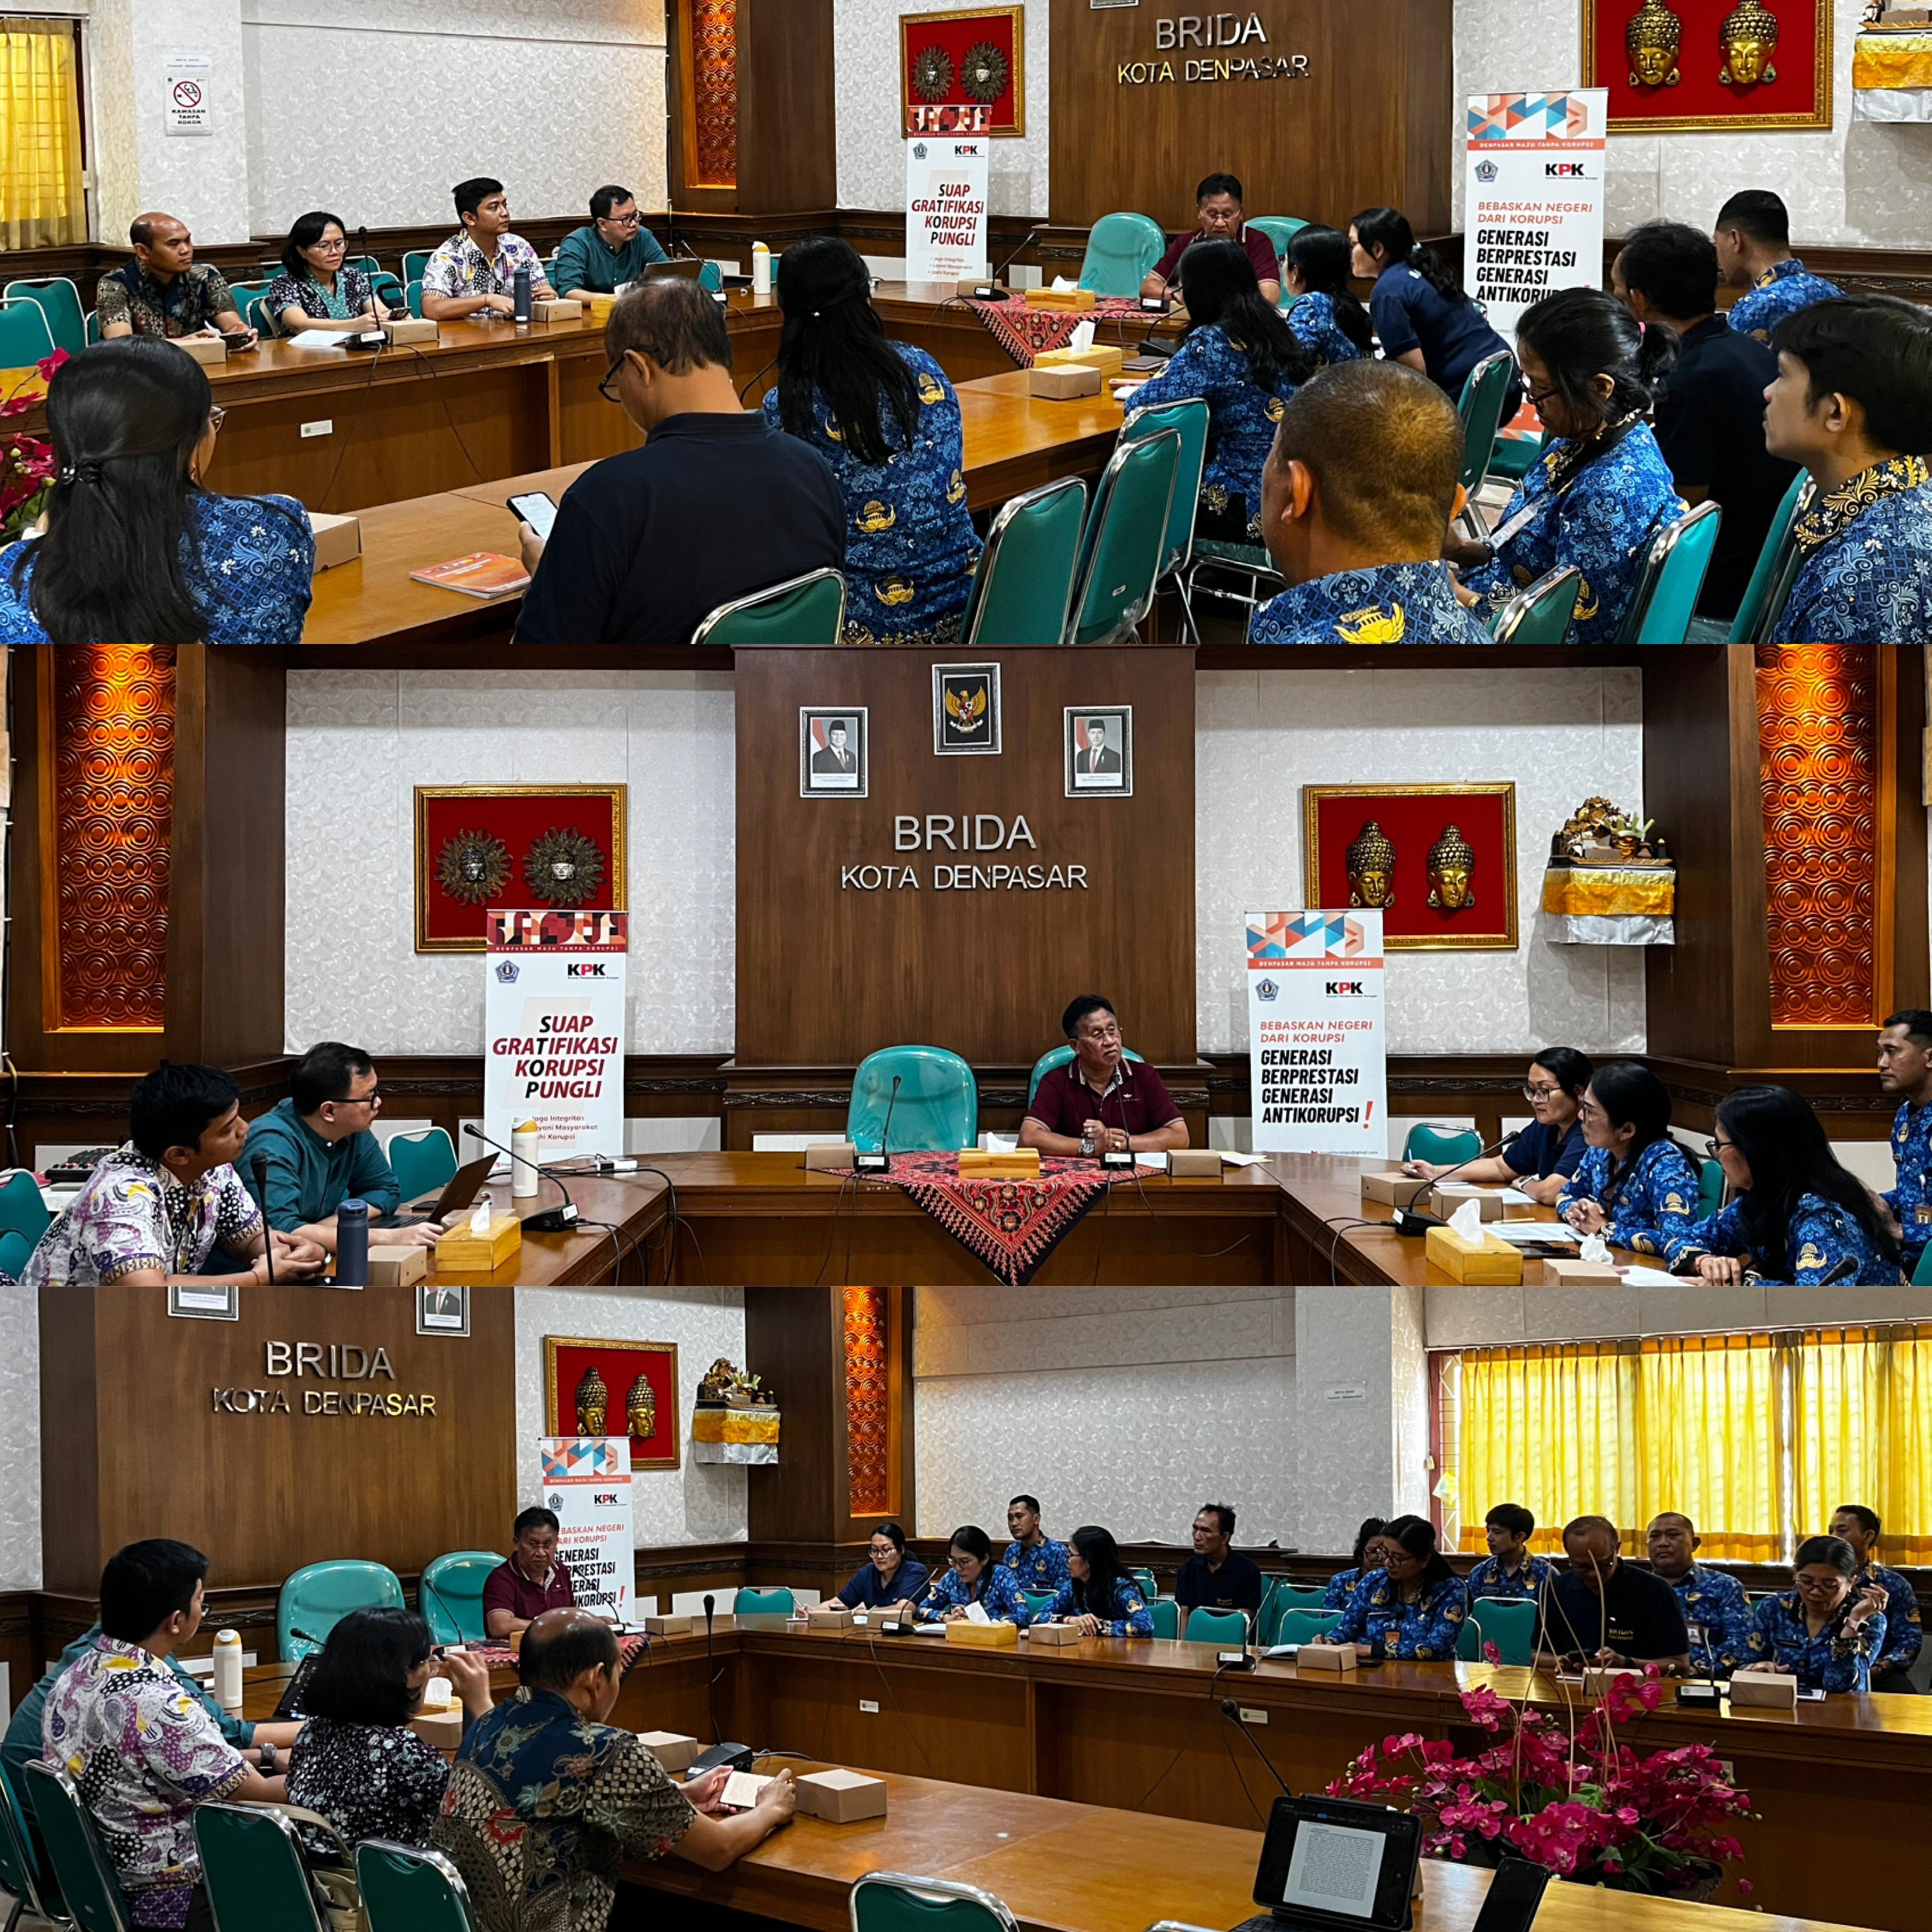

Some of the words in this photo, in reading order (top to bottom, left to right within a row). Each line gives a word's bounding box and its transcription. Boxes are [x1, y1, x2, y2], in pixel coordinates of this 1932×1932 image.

[1156, 12, 1267, 50] BRIDA
[1118, 61, 1175, 84] KOTA
[1185, 55, 1309, 81] DENPASAR
[955, 145, 977, 155] KPK
[1545, 164, 1584, 175] KPK
[938, 184, 970, 197] SUAP
[912, 199, 984, 214] GRATIFIKASI
[1479, 202, 1541, 212] BEBASKAN
[1546, 203, 1592, 213] NEGERI
[924, 216, 977, 230] KORUPSI
[1478, 214, 1505, 223] DARI
[1509, 214, 1563, 224] KORUPSI
[930, 232, 975, 246] PUNGLI
[1477, 230, 1549, 247] GENERASI
[1477, 248, 1576, 267] BERPRESTASI
[1477, 267, 1548, 284] GENERASI
[895, 814, 1037, 851] BRIDA
[841, 865, 919, 889] KOTA
[935, 865, 1087, 889] DENPASAR
[567, 963, 606, 975] KPK
[1326, 982, 1363, 994] KPK
[539, 1016, 593, 1033] SUAP
[1260, 1021, 1324, 1030] BEBASKAN
[1328, 1021, 1373, 1030] NEGERI
[1260, 1034, 1289, 1043] DARI
[1293, 1033, 1345, 1043] KORUPSI
[492, 1037, 618, 1055] GRATIFIKASI
[1261, 1049, 1332, 1065] GENERASI
[514, 1059, 605, 1077] KORUPSI
[1261, 1069, 1359, 1084] BERPRESTASI
[525, 1081, 602, 1098] PUNGLI
[1262, 1088, 1333, 1104] GENERASI
[266, 1341, 395, 1379] BRIDA
[213, 1387, 291, 1414] KOTA
[304, 1391, 437, 1417] DENPASAR
[594, 1494, 618, 1504] KPK
[596, 1524, 625, 1532] NEGERI
[574, 1535, 607, 1544] KORUPSI
